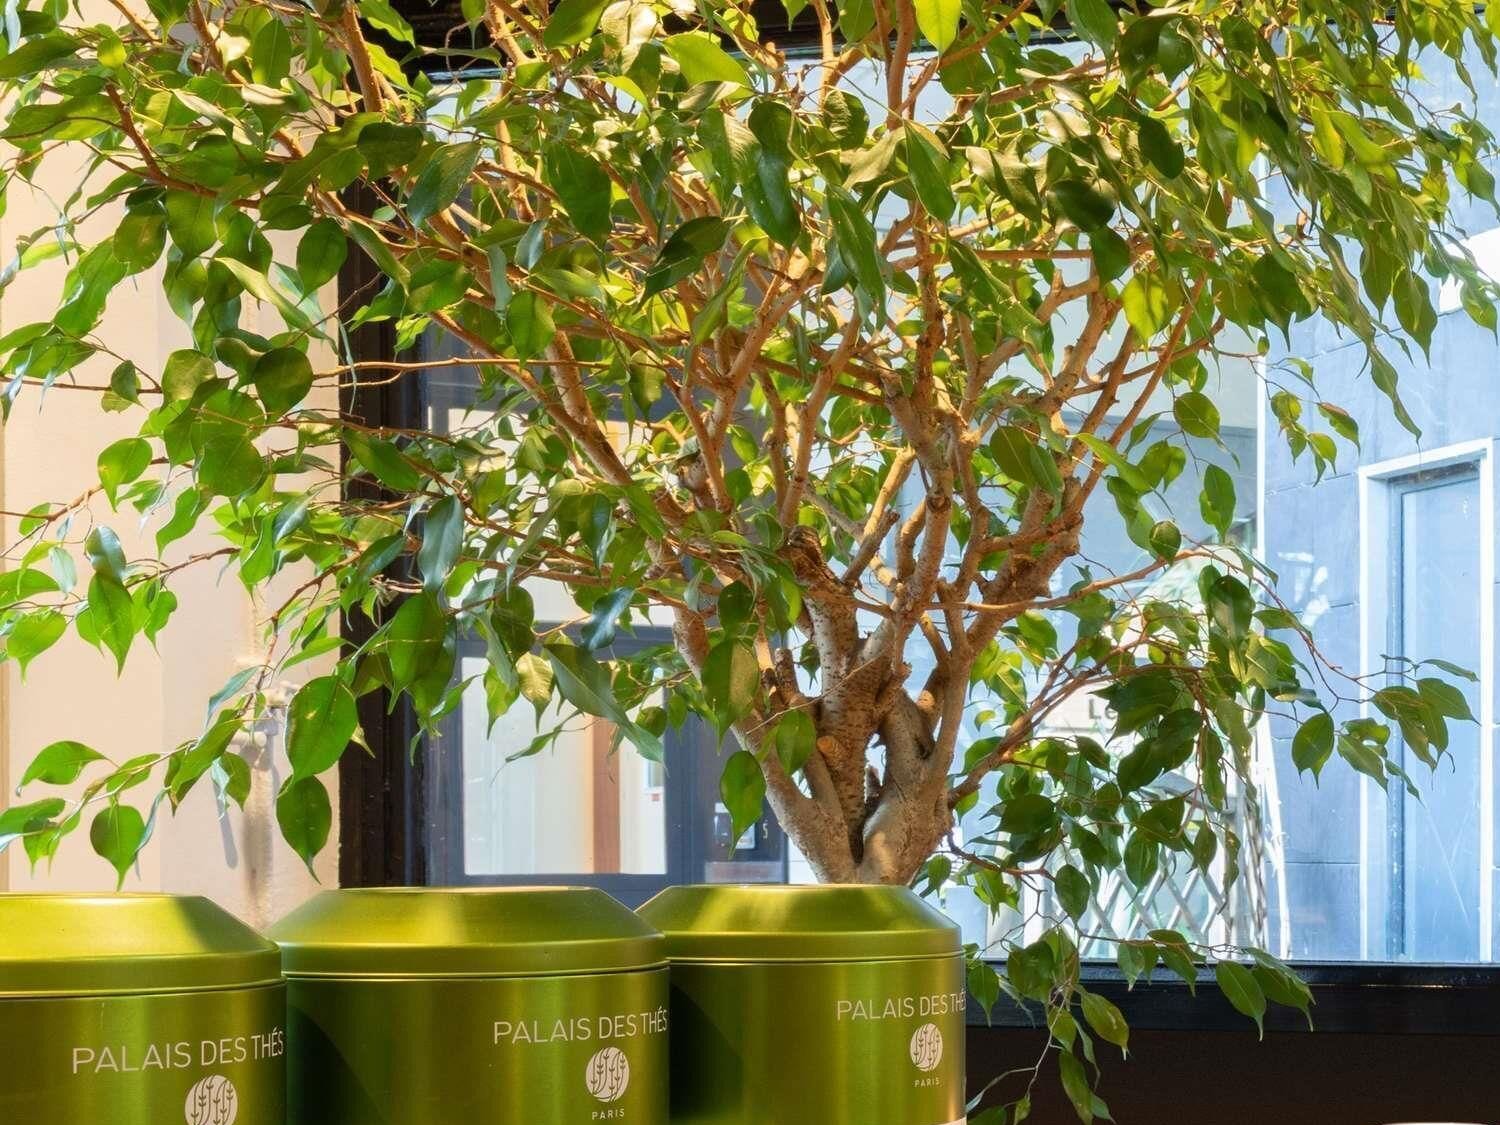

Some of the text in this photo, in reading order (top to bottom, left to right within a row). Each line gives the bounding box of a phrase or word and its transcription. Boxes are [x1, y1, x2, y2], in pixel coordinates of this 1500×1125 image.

[837, 994, 948, 1020] PALAIS DES
[494, 1006, 668, 1044] PALAIS DES THÉS
[72, 1026, 284, 1074] PALAIS DES THÉS
[914, 1077, 940, 1088] PARIS
[592, 1108, 625, 1120] PARIS
